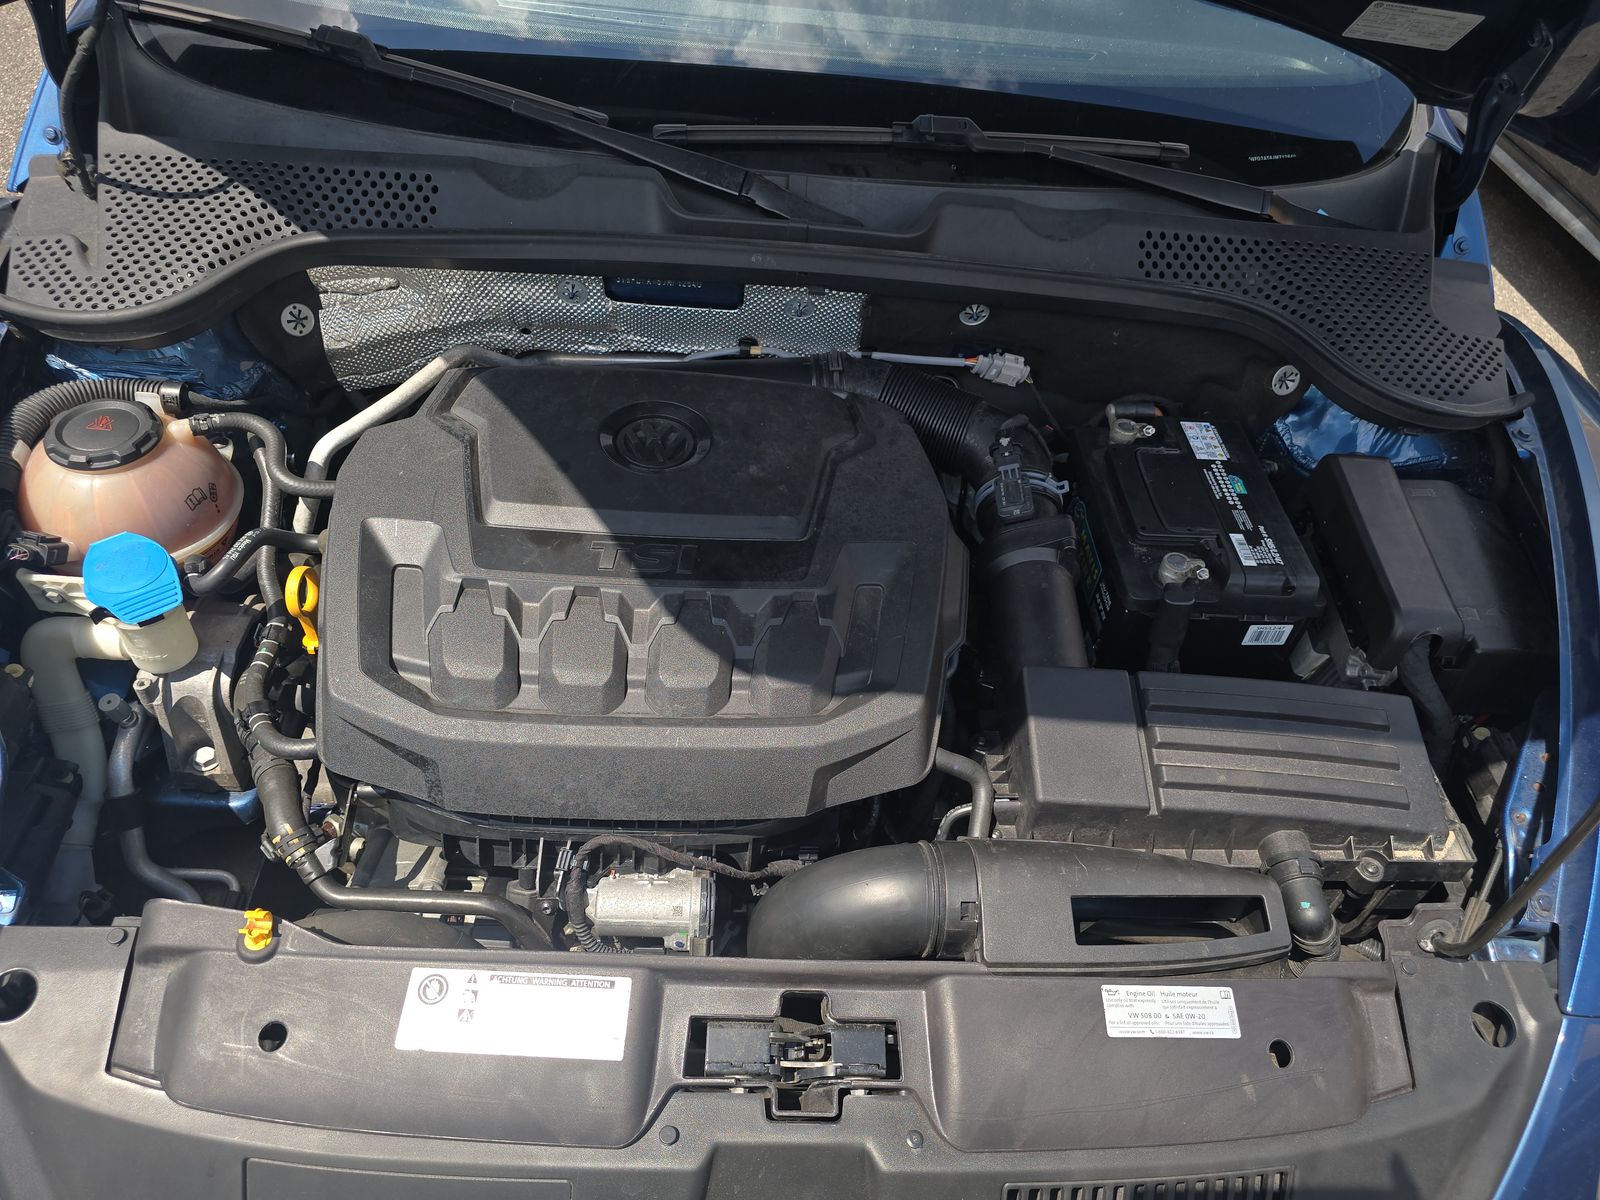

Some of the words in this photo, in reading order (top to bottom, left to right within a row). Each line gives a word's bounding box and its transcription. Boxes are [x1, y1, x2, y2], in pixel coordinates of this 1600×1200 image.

[590, 541, 699, 575] TSI
[492, 975, 528, 985] ACHTUNG
[532, 977, 568, 987] WARNING
[570, 979, 611, 988] ATTENTION
[1125, 990, 1146, 998] Engine
